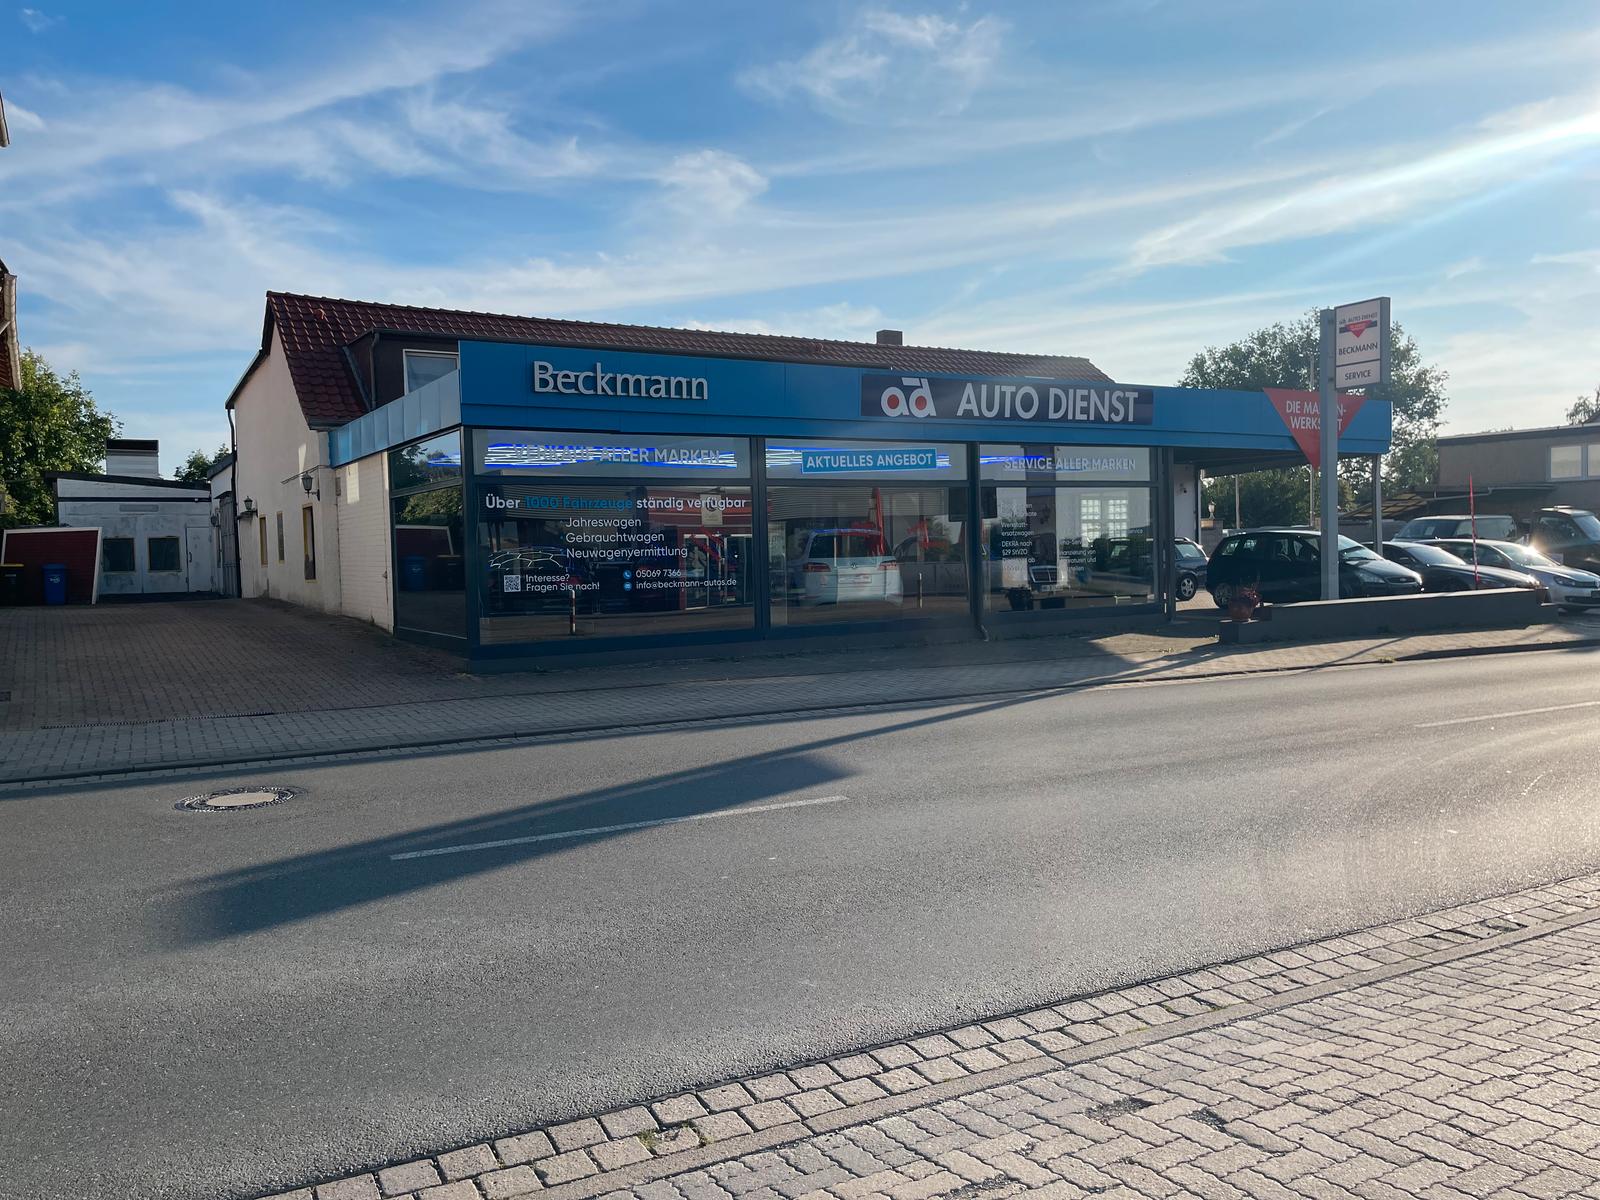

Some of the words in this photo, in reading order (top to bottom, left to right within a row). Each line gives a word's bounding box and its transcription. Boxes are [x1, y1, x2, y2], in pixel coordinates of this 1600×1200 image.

[1338, 342, 1378, 356] BECKMANN
[533, 360, 709, 400] Beckmann
[1344, 369, 1372, 381] SERVICE
[956, 382, 1040, 420] AUTO
[1048, 387, 1139, 422] DIENST
[1286, 400, 1301, 414] DIE
[1303, 401, 1347, 416] MAN-
[1290, 416, 1343, 431] WERKST
[599, 448, 649, 462] ALLER
[654, 449, 720, 463] MARKEN
[806, 455, 873, 468] AKTUELLES
[877, 453, 933, 466] ANGEBOT
[1004, 457, 1053, 470] SERVICE
[1055, 458, 1088, 470] ALLER
[1092, 459, 1136, 470] MARKEN
[485, 494, 521, 509] Über
[525, 496, 559, 508] 1000
[562, 495, 633, 511] Fahrzeuge
[636, 496, 684, 511] ständig
[687, 496, 747, 510] verfügbar
[565, 517, 642, 529] Jahreswagen
[565, 532, 665, 544] Gebrauchtwagen
[566, 546, 688, 560] Neuwagenvermittlung
[525, 574, 570, 583] Interesse?
[635, 569, 661, 578] 05069
[663, 569, 682, 577] 7366
[526, 584, 559, 593] Fragen
[560, 583, 574, 592] Sie
[575, 582, 600, 591] nach!
[636, 578, 737, 590] info@beckmann-autos.de
